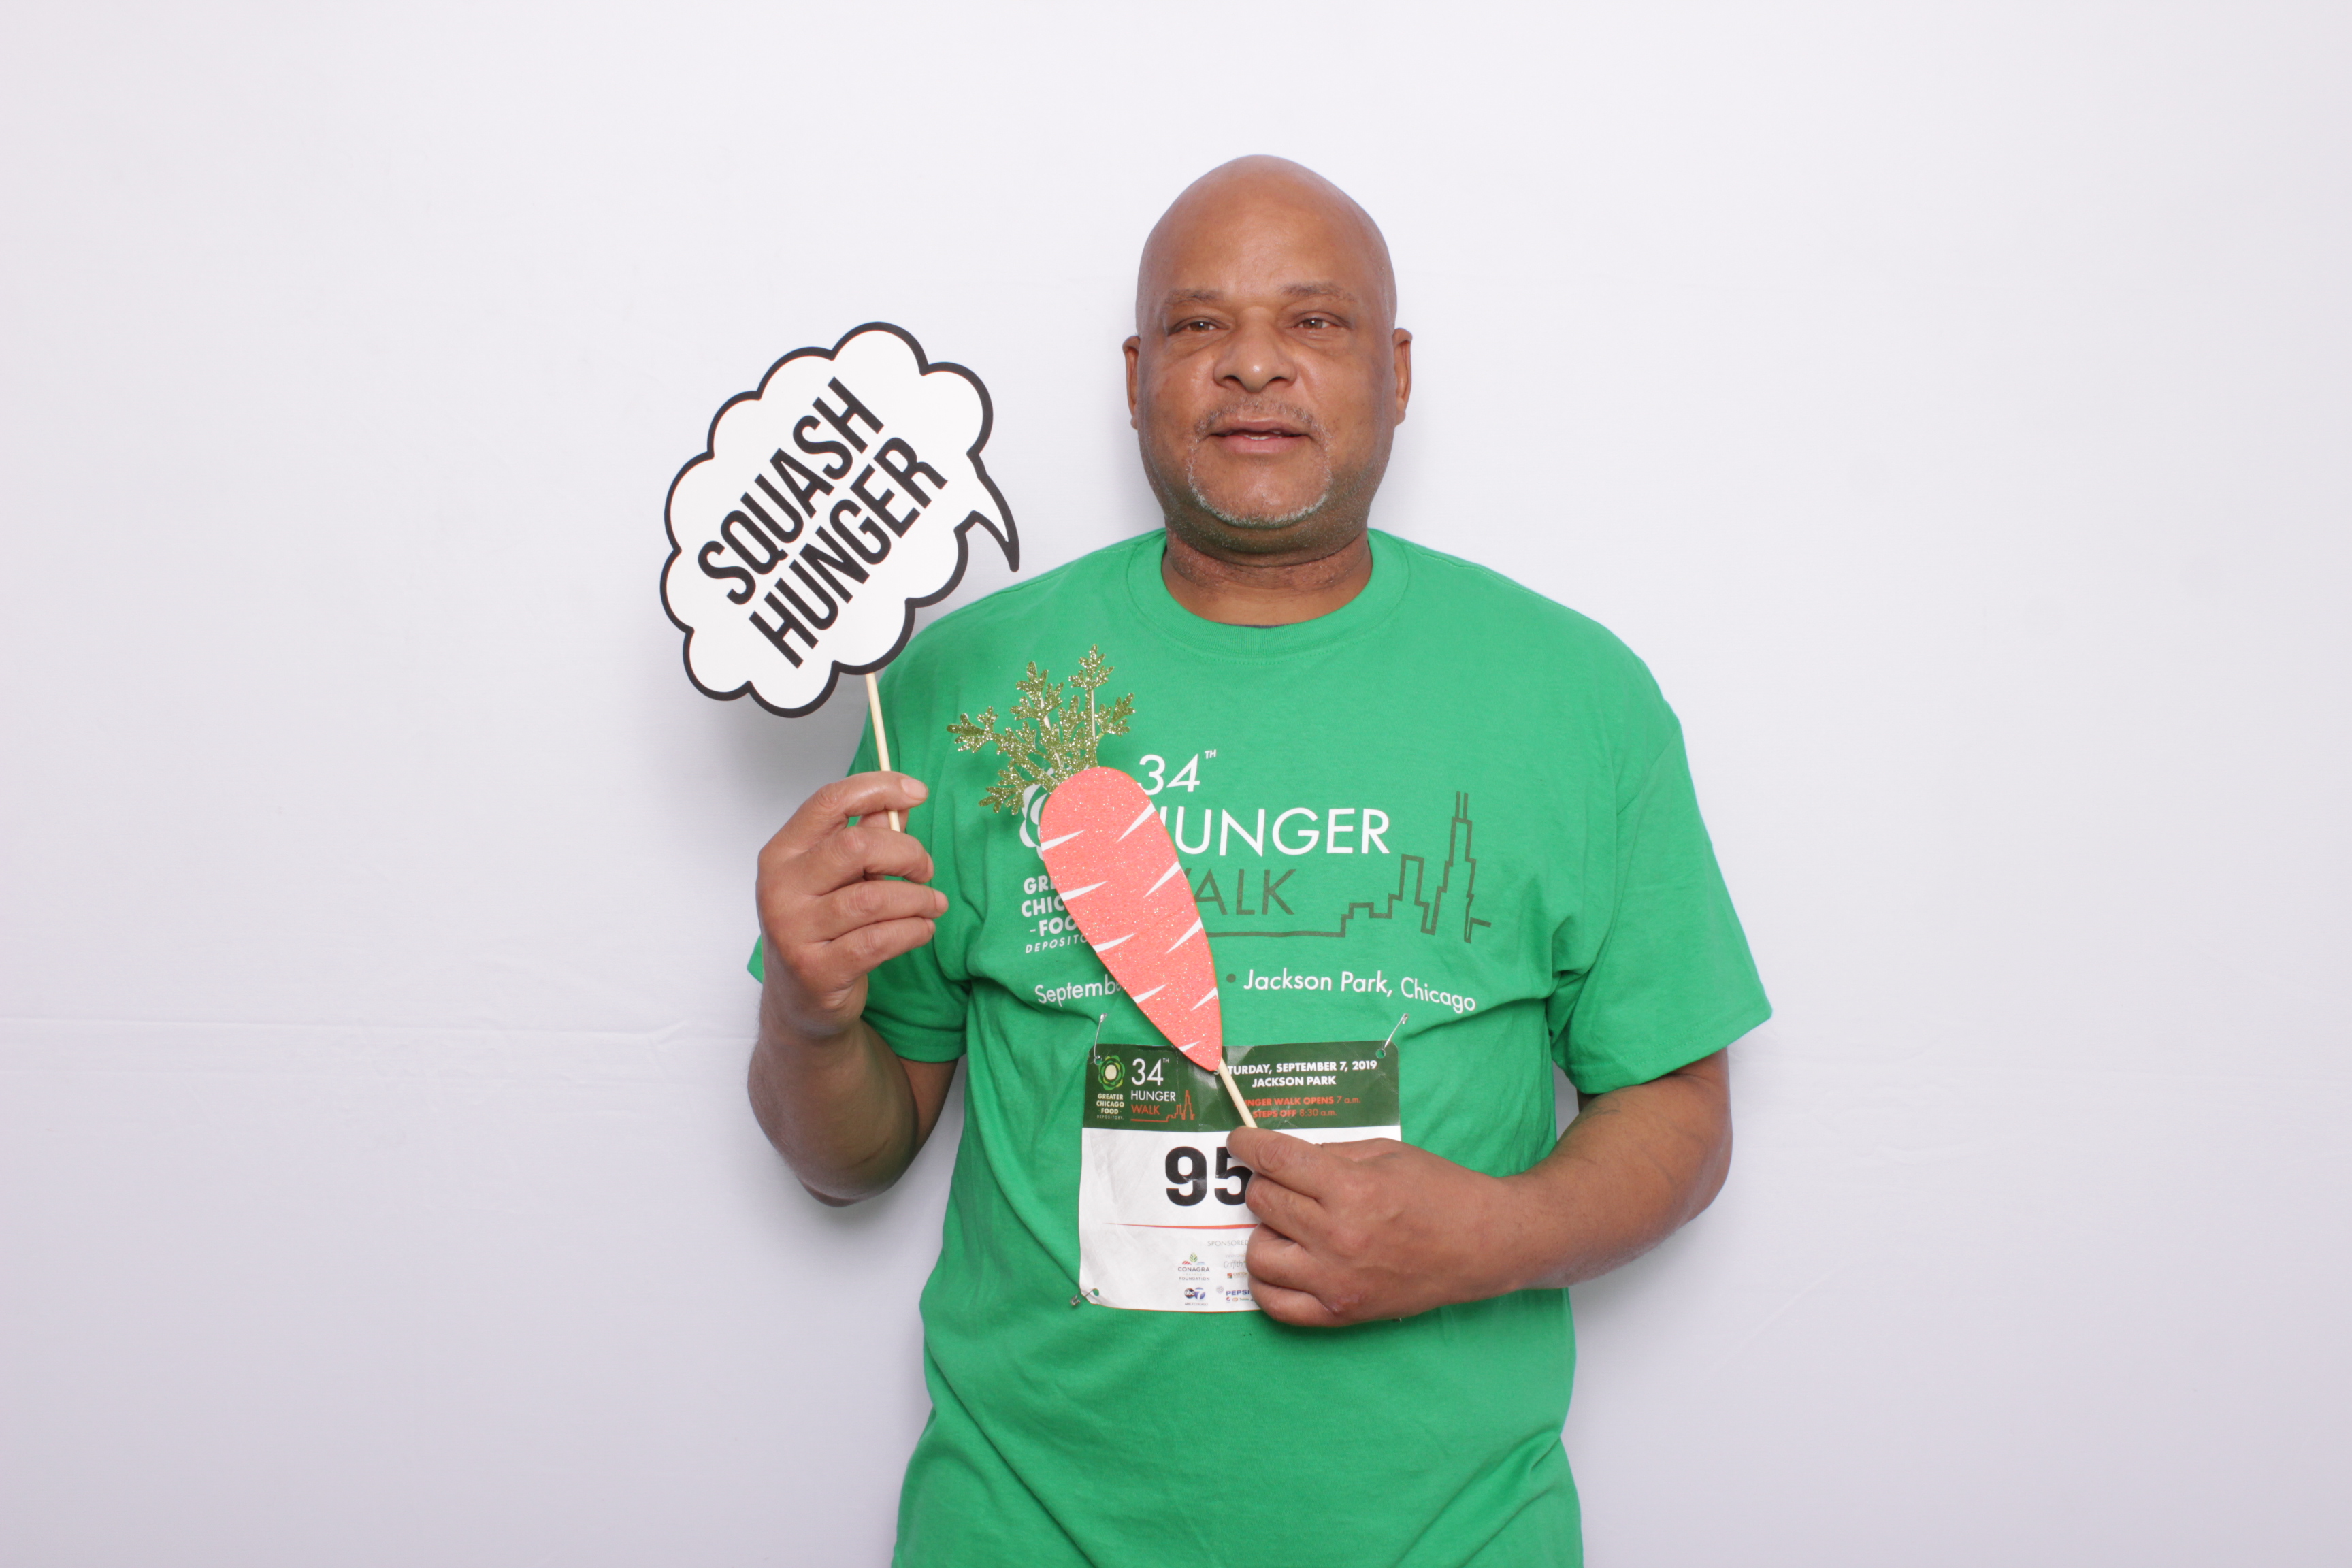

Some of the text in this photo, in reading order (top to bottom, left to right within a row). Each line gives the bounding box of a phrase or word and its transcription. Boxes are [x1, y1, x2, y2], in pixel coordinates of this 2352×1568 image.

[698, 376, 884, 605] SQUASH
[749, 437, 948, 669] HUNGER
[1160, 806, 1390, 857] UNGER
[1184, 868, 1296, 915] ALK
[1022, 894, 1065, 917] CHIC
[1026, 934, 1088, 953] DEPOSITO
[1035, 974, 1122, 1007] Septembe
[1243, 968, 1476, 1013] Jackson Park, Chicago
[1213, 1060, 1377, 1075] TURDAY, SEPTEMBER 7, 2019
[1252, 1075, 1337, 1088] JACKSON PARK
[1130, 1090, 1176, 1102] HUNGER
[1235, 1098, 1273, 1107] NGER
[1274, 1098, 1301, 1106] WALK
[1303, 1096, 1334, 1105] OPENS
[1337, 1096, 1343, 1104] 7
[1130, 1104, 1160, 1115] WALK
[1252, 1110, 1278, 1119] STEPS
[1279, 1110, 1296, 1118] OFF
